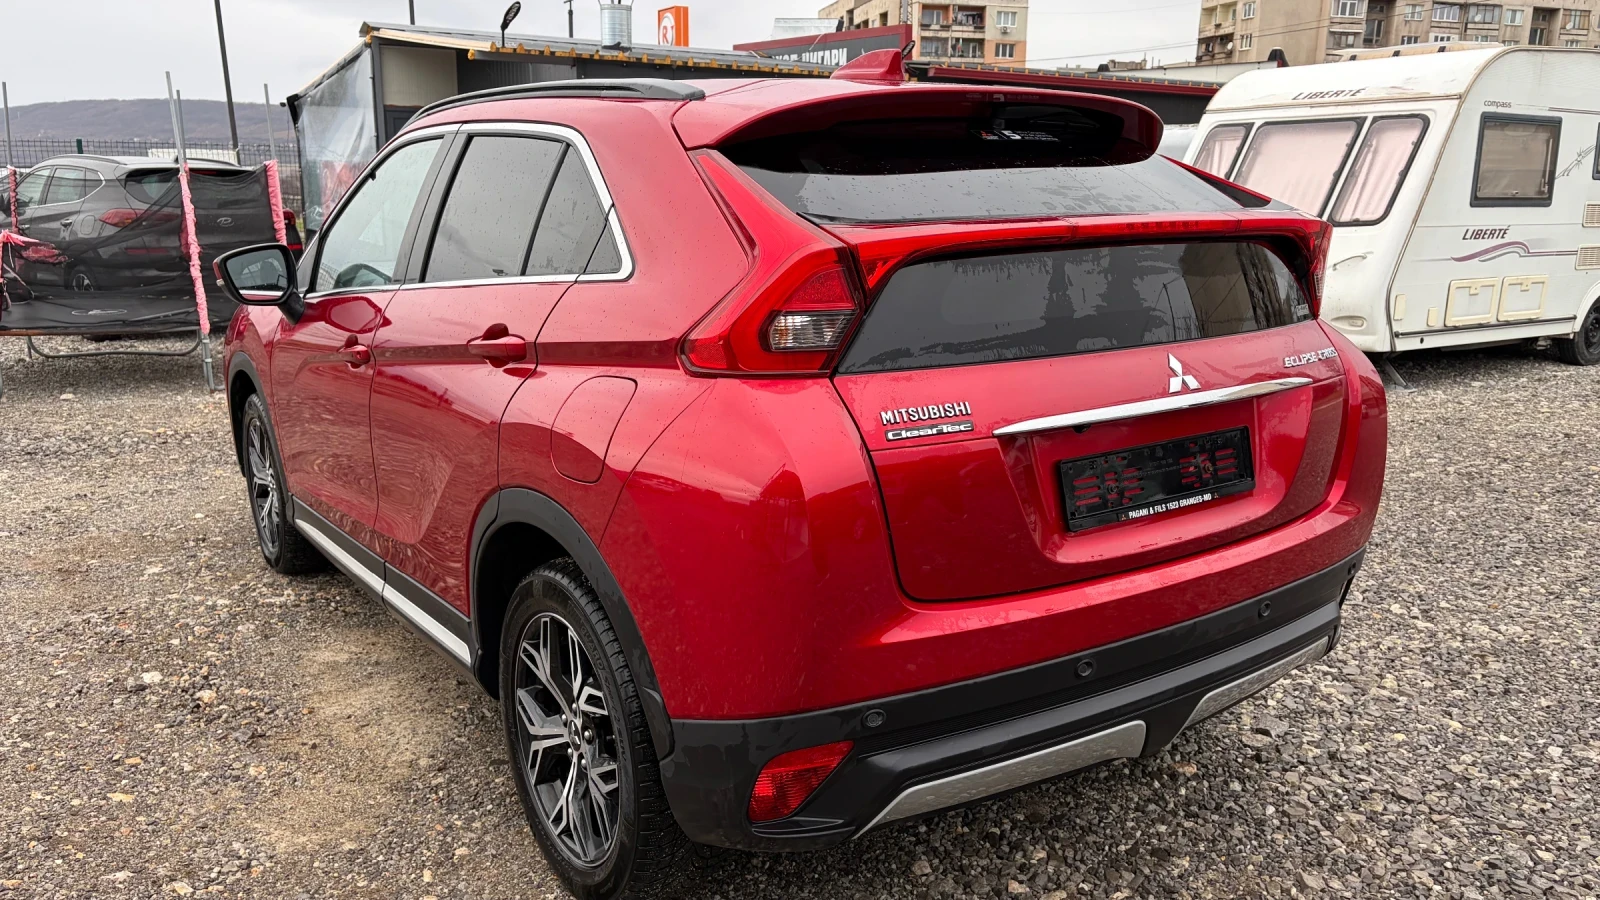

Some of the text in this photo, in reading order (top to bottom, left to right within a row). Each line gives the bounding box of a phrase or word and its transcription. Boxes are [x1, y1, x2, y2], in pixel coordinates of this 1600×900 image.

[1483, 100, 1512, 108] compass
[1001, 130, 1022, 140] 5
[1462, 224, 1511, 240] LIBERTÉ
[1284, 352, 1317, 367] ECLIPSE
[880, 401, 972, 425] MITSUBISHI
[887, 423, 972, 440] ClearTec
[1129, 508, 1149, 519] PAGANI
[1149, 506, 1154, 515] &
[1154, 504, 1166, 513] FILS
[1166, 501, 1179, 510] 1523
